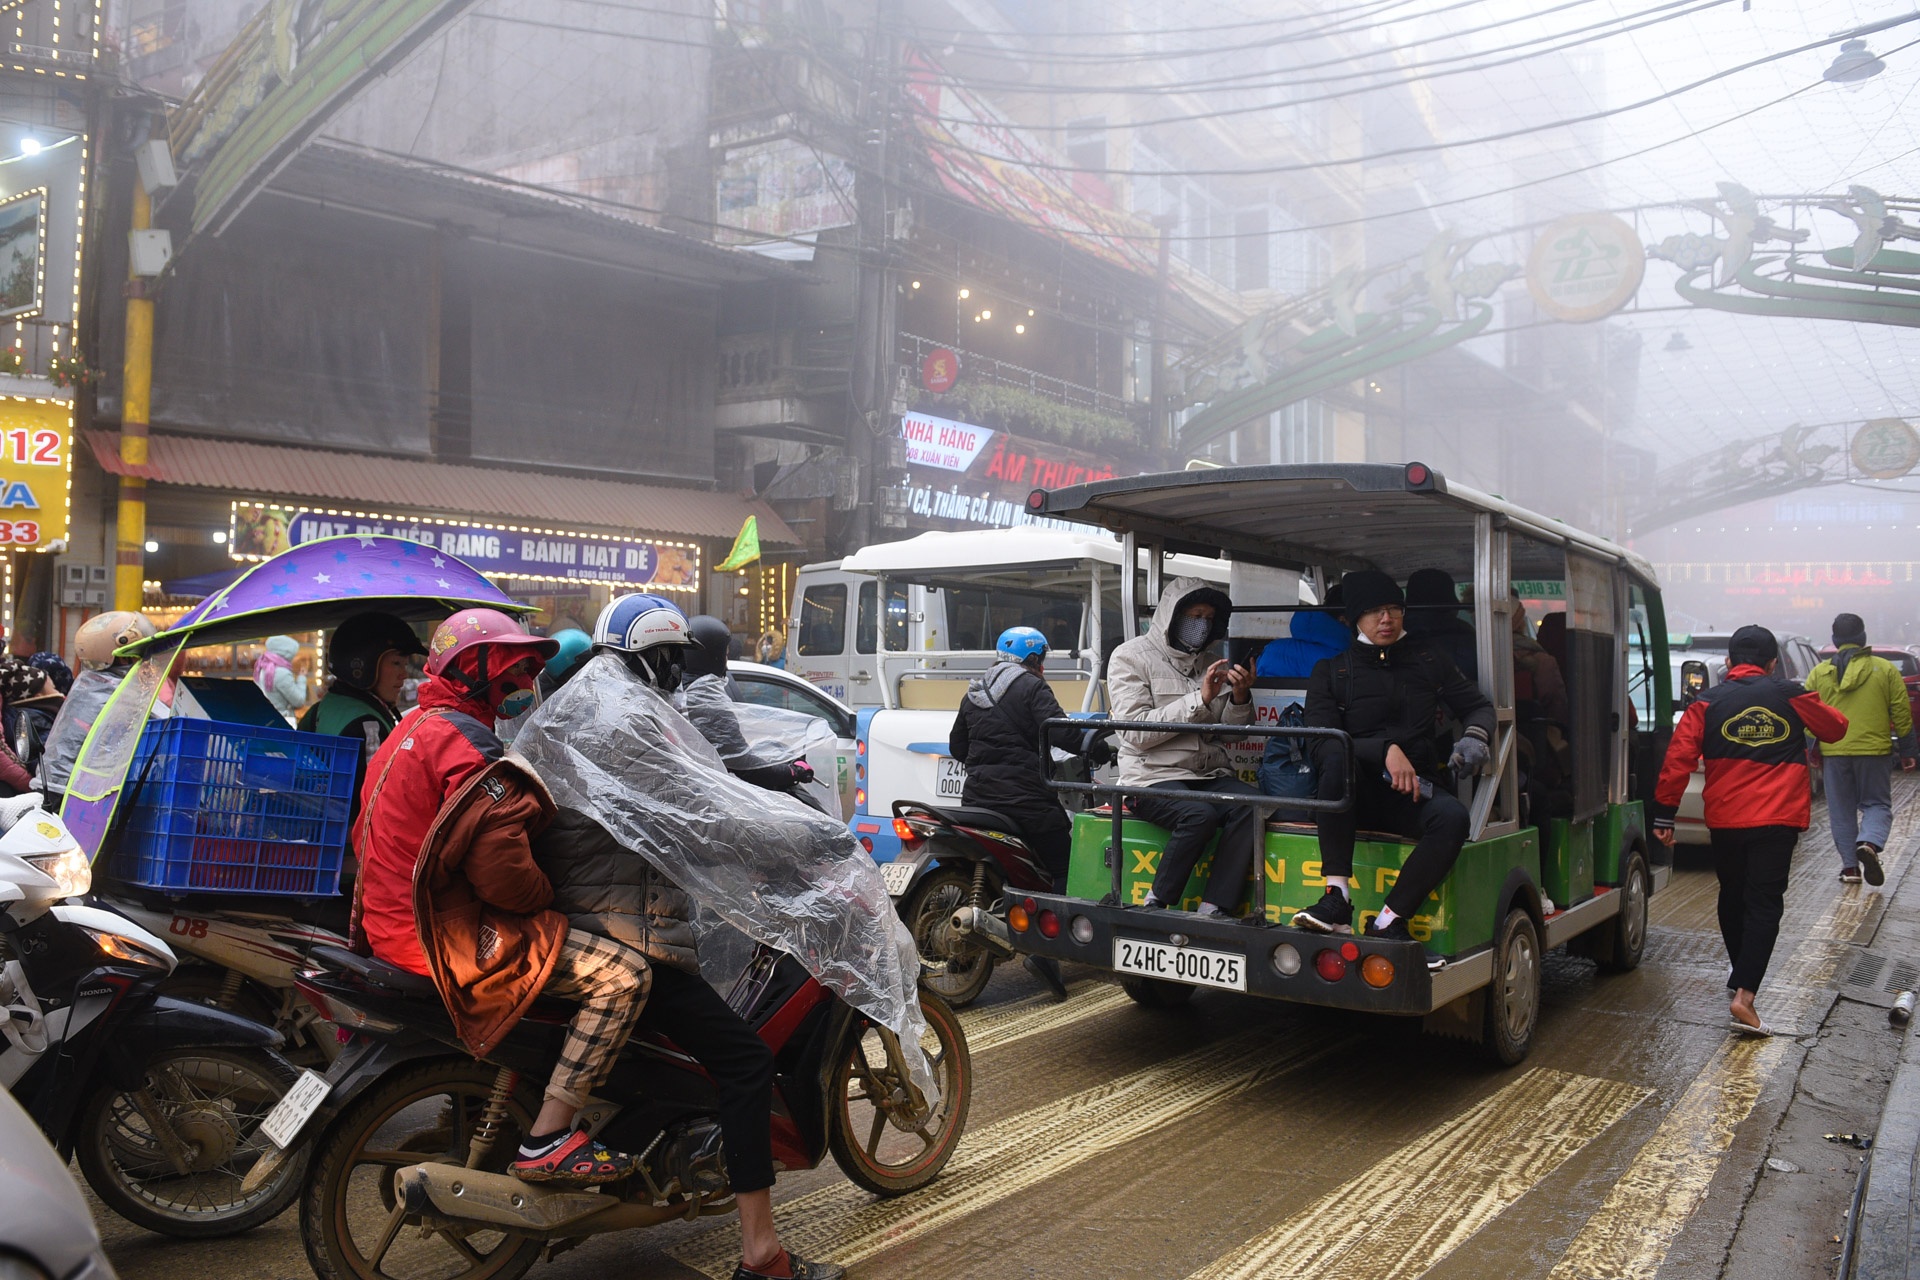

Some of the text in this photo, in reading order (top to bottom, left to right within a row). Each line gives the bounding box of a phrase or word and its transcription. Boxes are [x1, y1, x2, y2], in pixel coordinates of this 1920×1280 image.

[0, 430, 60, 465] 12
[904, 420, 977, 452] NHÀ HÀNG
[0, 477, 36, 508] A
[441, 533, 500, 559] RANG
[520, 538, 576, 565] BÁNH
[582, 544, 620, 570] HẠT
[625, 545, 648, 570] DẺ
[169, 915, 209, 939] 08
[1122, 943, 1240, 984] 24HC-000.25
[80, 987, 113, 997] HONDA
